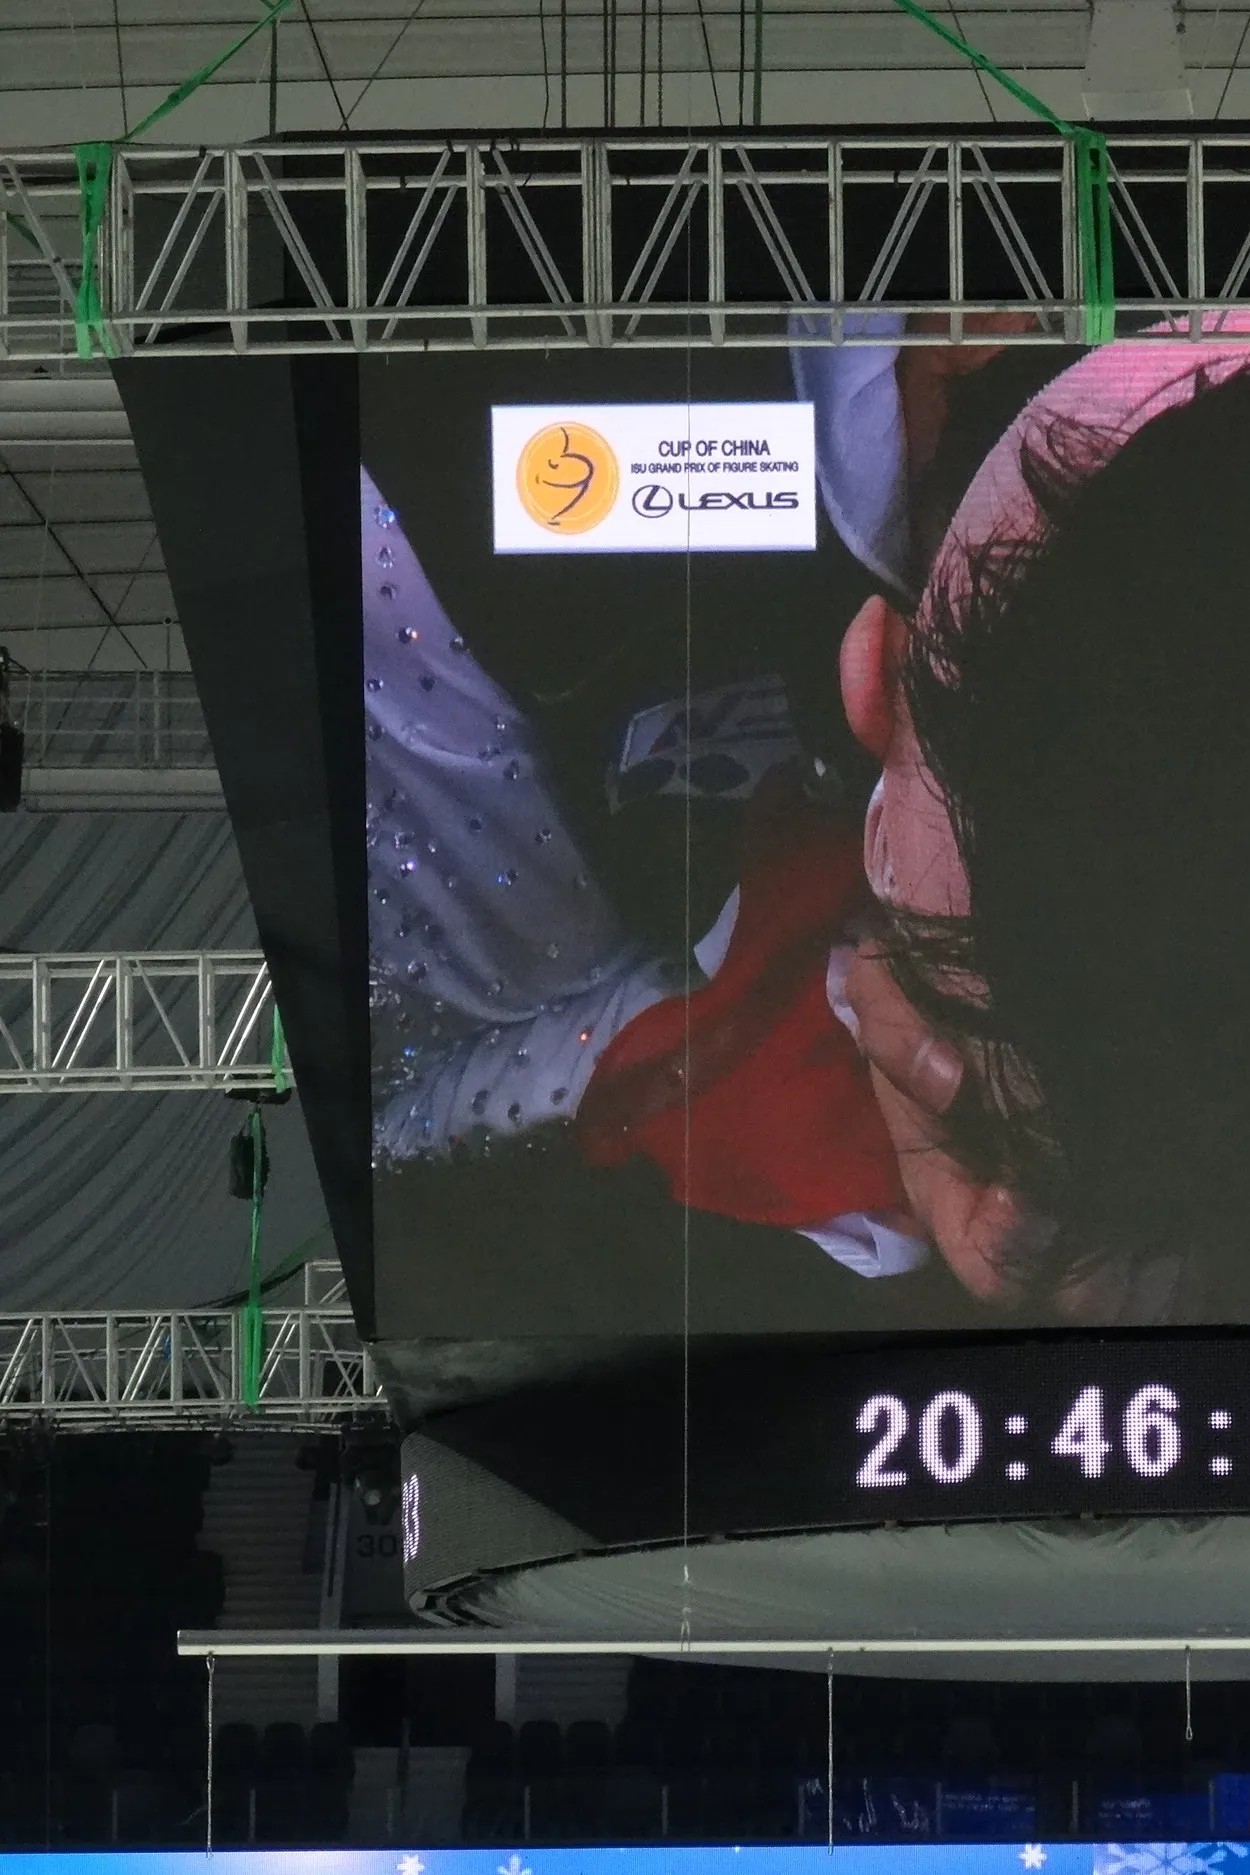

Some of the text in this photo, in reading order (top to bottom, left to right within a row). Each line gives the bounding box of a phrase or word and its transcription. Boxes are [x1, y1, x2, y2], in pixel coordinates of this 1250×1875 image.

[658, 439, 771, 457] CUP OF CHINA
[630, 461, 799, 474] ISU GRAND PRIX OF FIGURE SKATING
[678, 491, 799, 511] LEXUS
